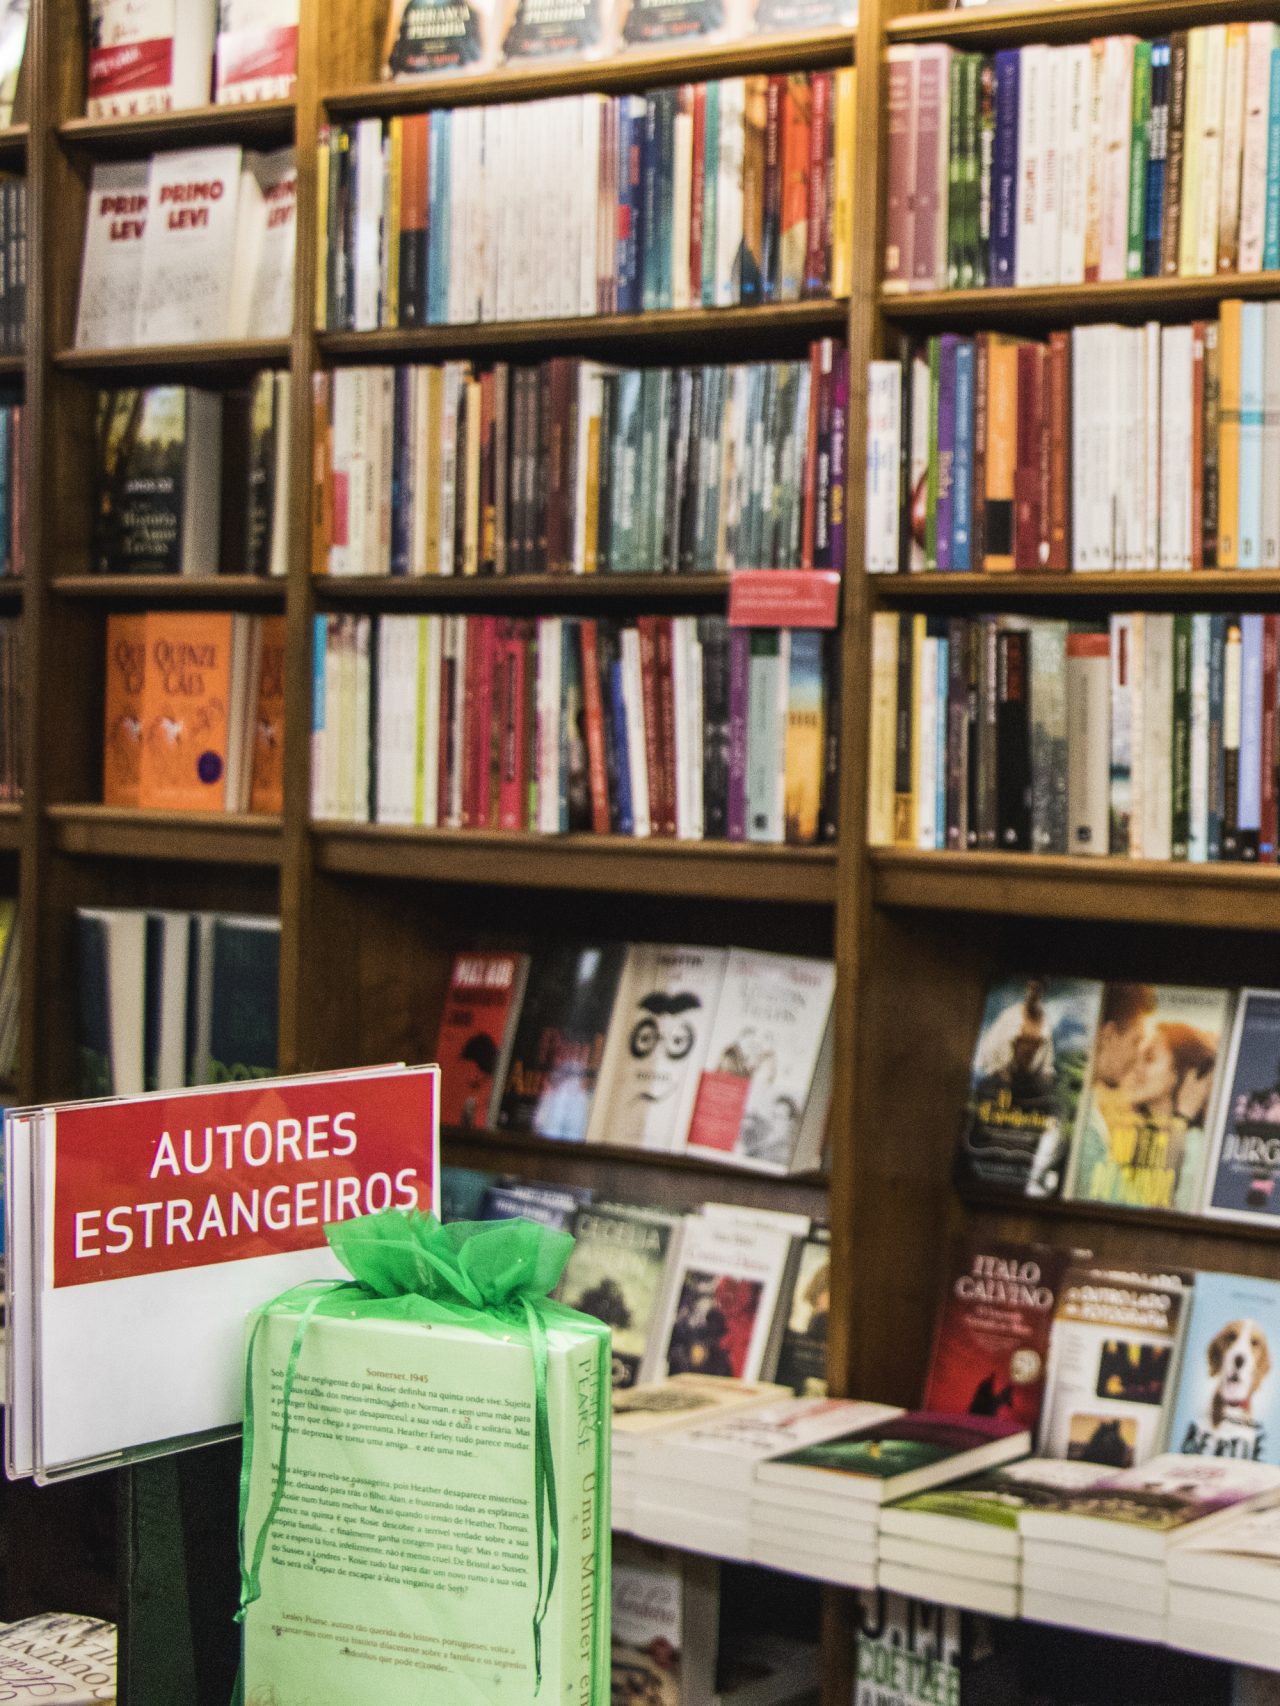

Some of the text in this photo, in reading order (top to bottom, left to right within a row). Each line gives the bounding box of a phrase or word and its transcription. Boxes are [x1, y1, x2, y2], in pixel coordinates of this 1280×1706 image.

[159, 179, 225, 205] PRIMO
[109, 220, 145, 241] LEV
[167, 207, 211, 231] LEVI
[149, 1111, 358, 1180] AUTORES
[74, 1168, 420, 1259] ESTRANGEIROS
[972, 1254, 1042, 1286] ITALO
[954, 1275, 1055, 1310] CALVINO
[365, 1367, 429, 1384] Somerset, 1945
[311, 1372, 349, 1389] negligente
[398, 1384, 426, 1397] definha
[438, 1389, 463, 1404] quinta
[504, 1397, 531, 1412] Sujeita
[577, 1357, 592, 1451] PEARSE
[417, 1400, 449, 1415] Norman,
[301, 1425, 333, 1441] depressa
[397, 1425, 428, 1439] Heather
[474, 1438, 501, 1450] parece
[503, 1439, 529, 1452] mudar
[481, 1423, 511, 1436] solitária.
[579, 1470, 597, 1663] Uma Mulher
[857, 1641, 961, 1705] COETZEE
